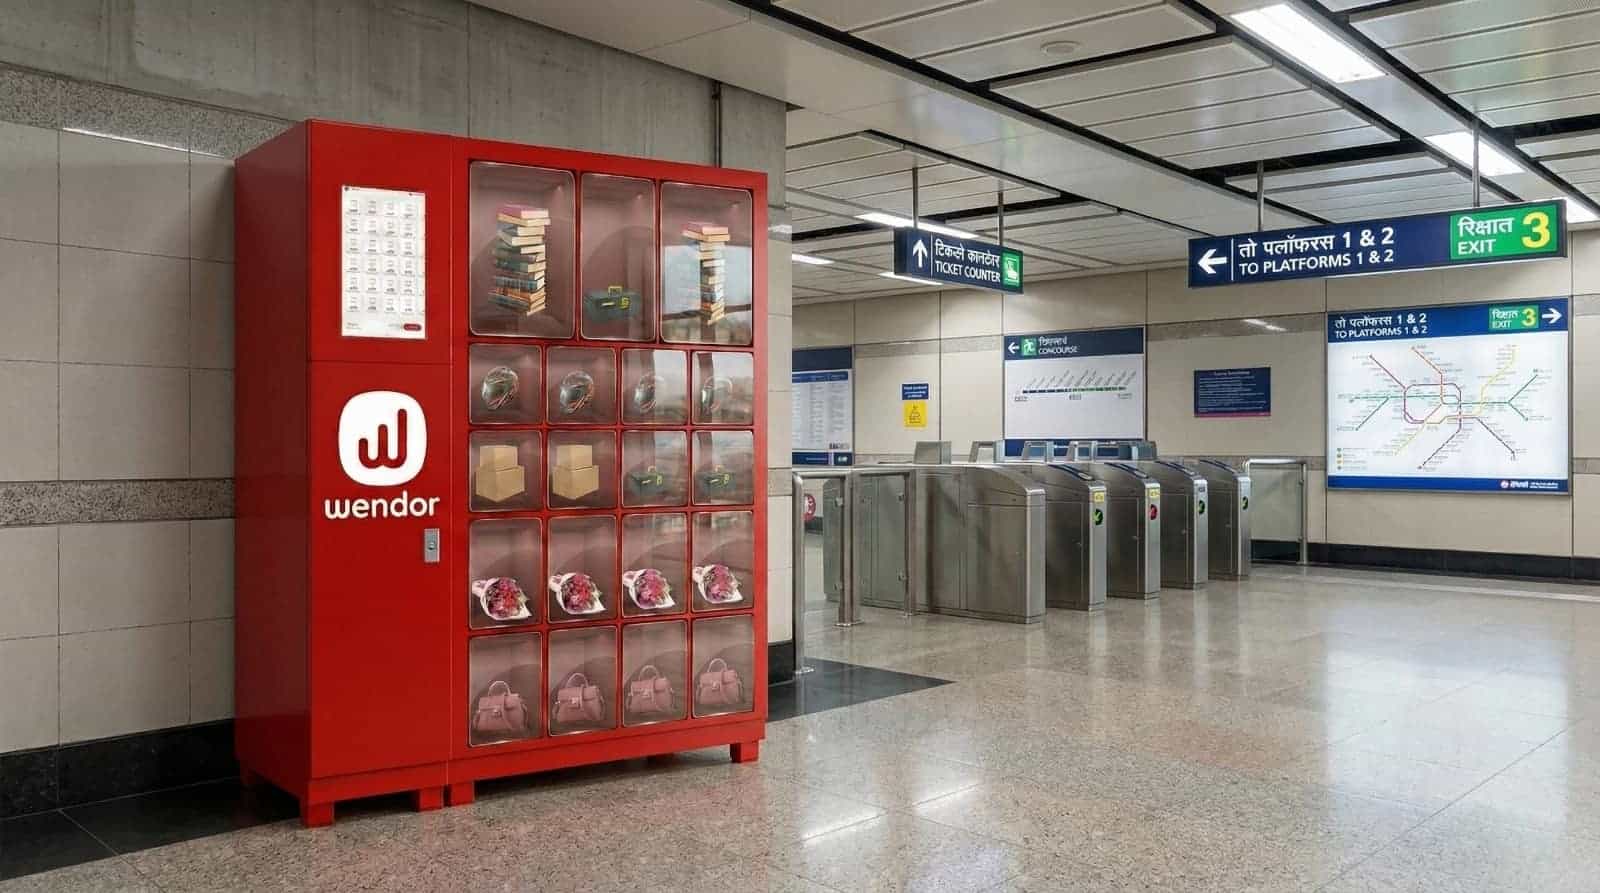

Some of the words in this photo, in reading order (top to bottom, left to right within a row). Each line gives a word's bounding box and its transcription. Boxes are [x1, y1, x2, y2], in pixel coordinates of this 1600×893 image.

[1521, 211, 1550, 248] 3
[1238, 238, 1257, 259] तो
[1342, 232, 1351, 248] 1
[1359, 229, 1375, 247] &
[1381, 227, 1394, 245] 2
[1457, 239, 1496, 255] EXIT
[935, 260, 963, 276] TICKET
[964, 266, 1001, 283] COUNTER
[1239, 262, 1259, 275] TO
[1263, 253, 1351, 273] PLATFORMS
[1356, 253, 1363, 265] 1
[1368, 251, 1381, 264] &
[1383, 249, 1394, 263] 2
[1397, 314, 1402, 324] 1
[1406, 313, 1416, 324] &
[1419, 313, 1427, 323] 2
[1522, 308, 1536, 326] 3
[1335, 330, 1347, 338] TO
[1348, 327, 1402, 338] PLATFORMS
[1404, 327, 1409, 335] 1
[1411, 326, 1419, 334] &
[1421, 325, 1428, 334] 2
[324, 490, 440, 519] wendor
